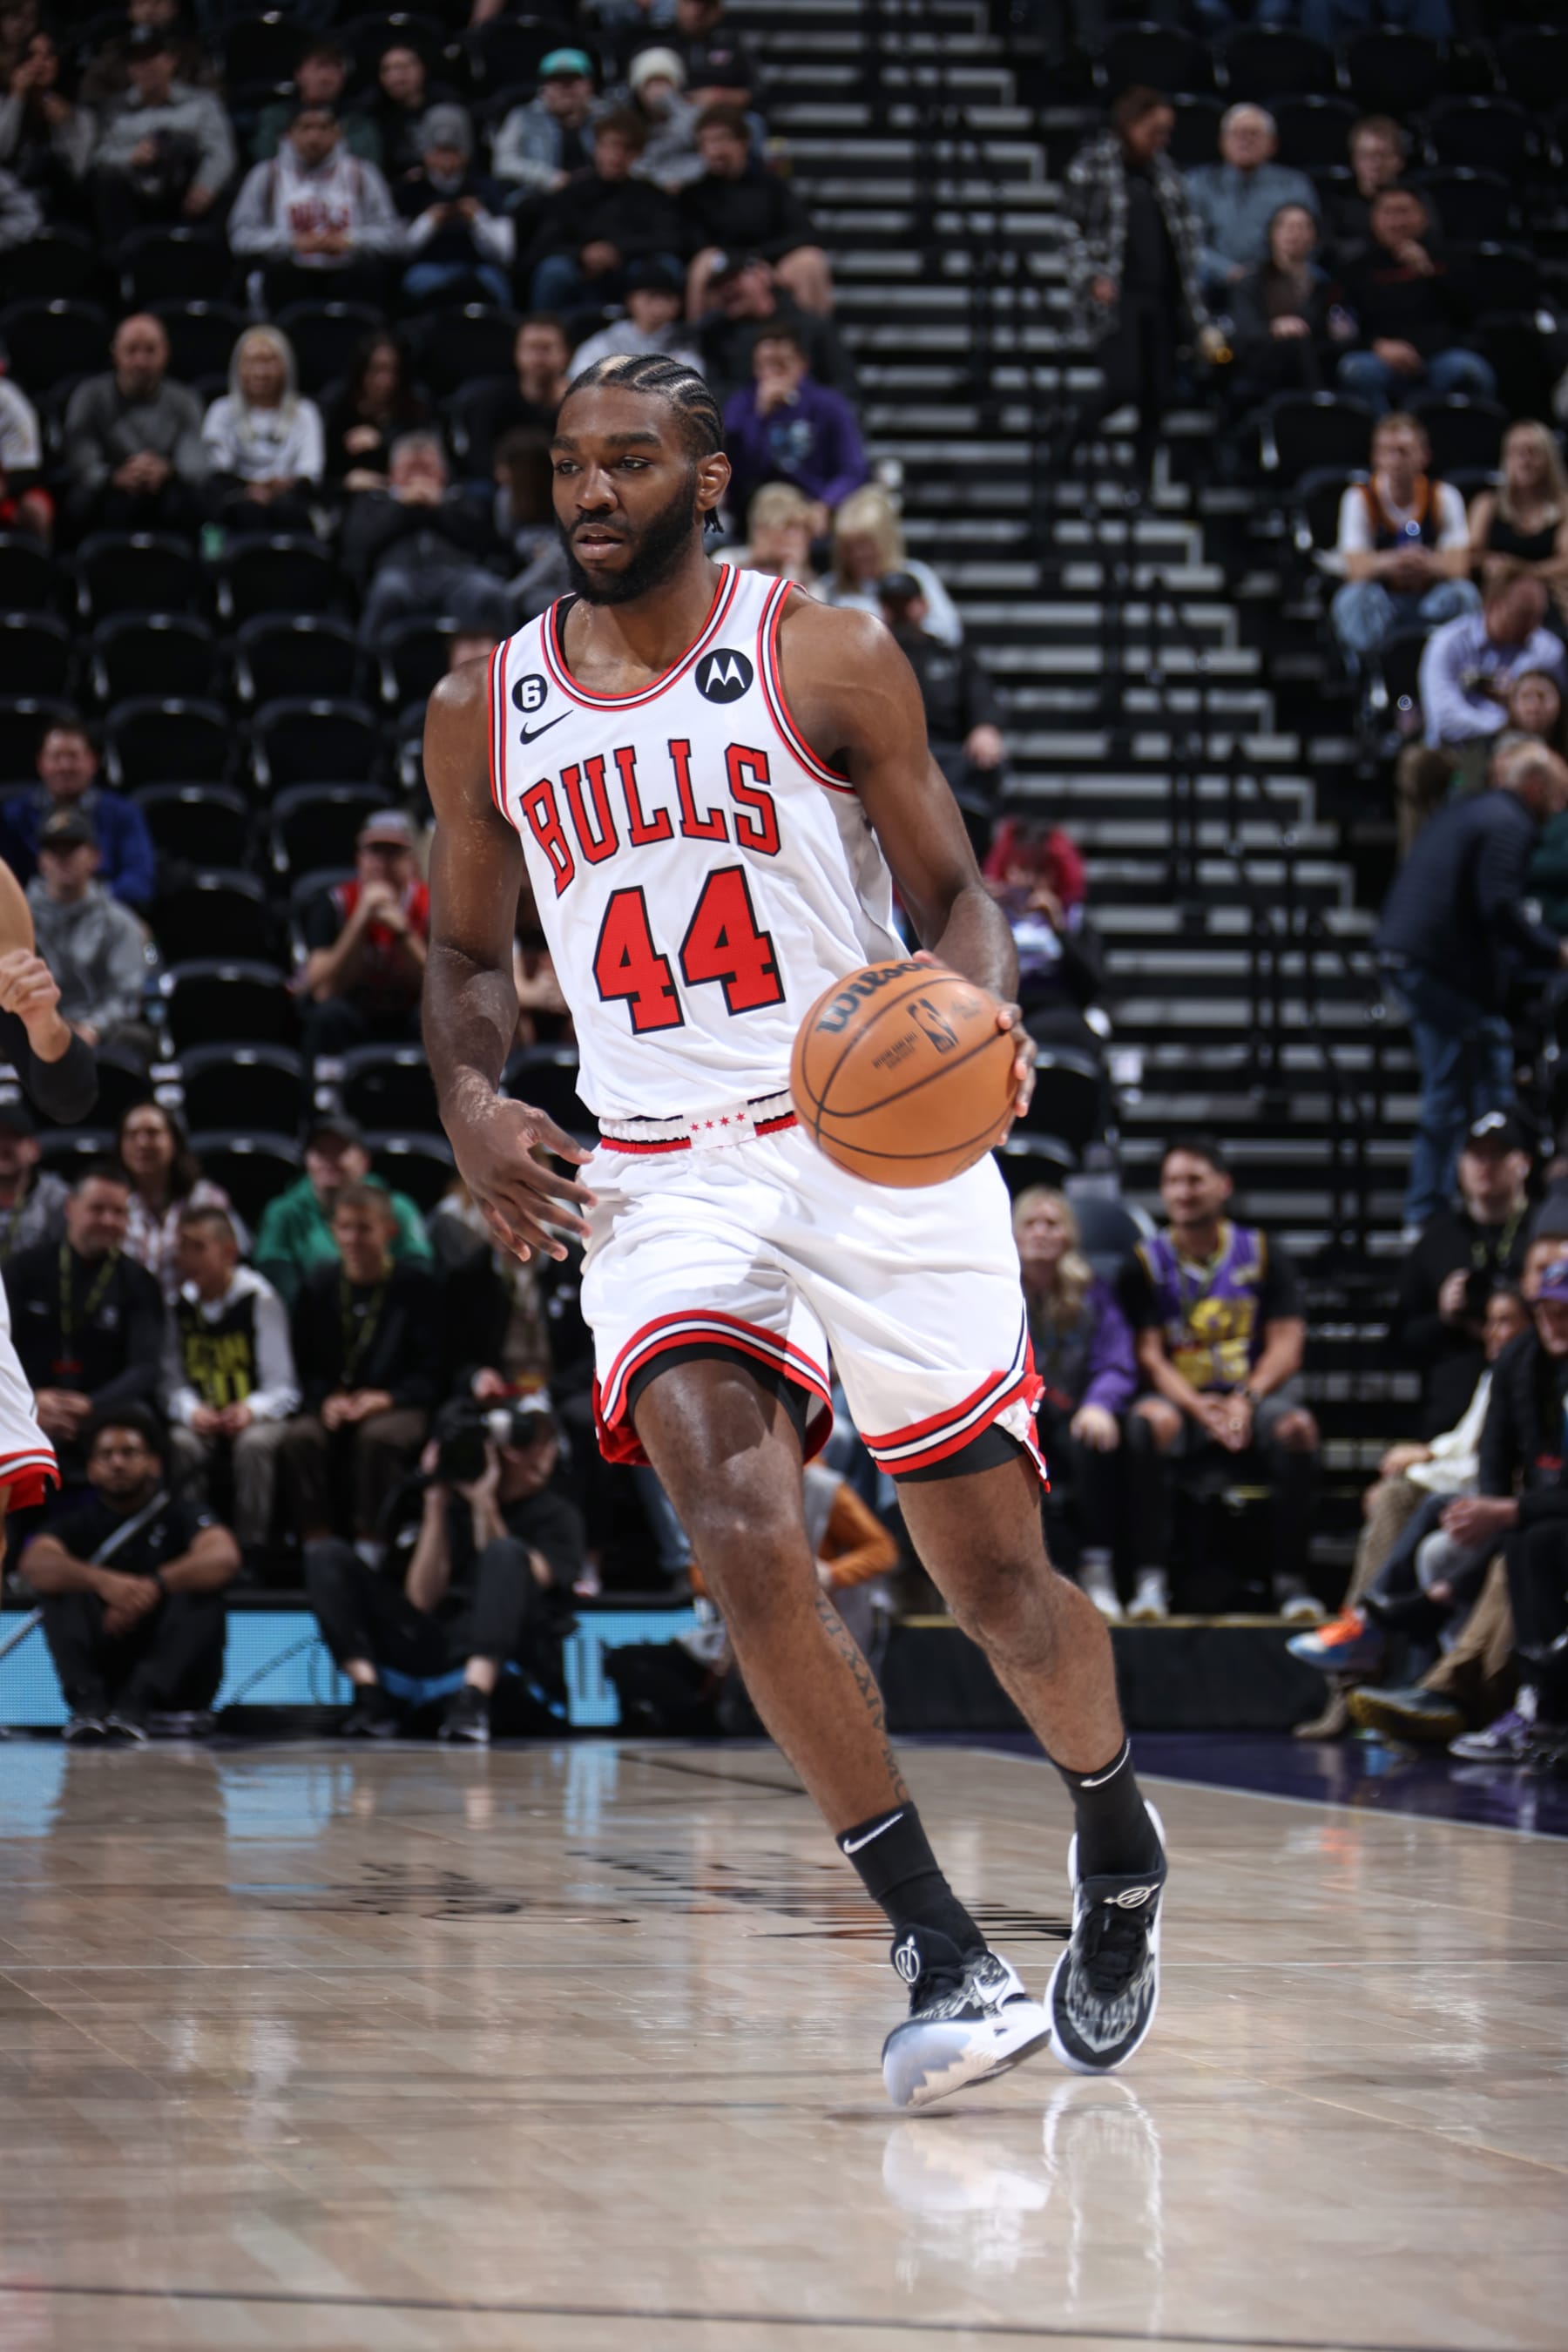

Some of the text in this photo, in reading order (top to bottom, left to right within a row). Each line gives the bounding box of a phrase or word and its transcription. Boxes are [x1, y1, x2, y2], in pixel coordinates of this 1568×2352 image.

[522, 679, 540, 708] 6
[519, 739, 781, 899] BULLS
[592, 864, 786, 1035] 44
